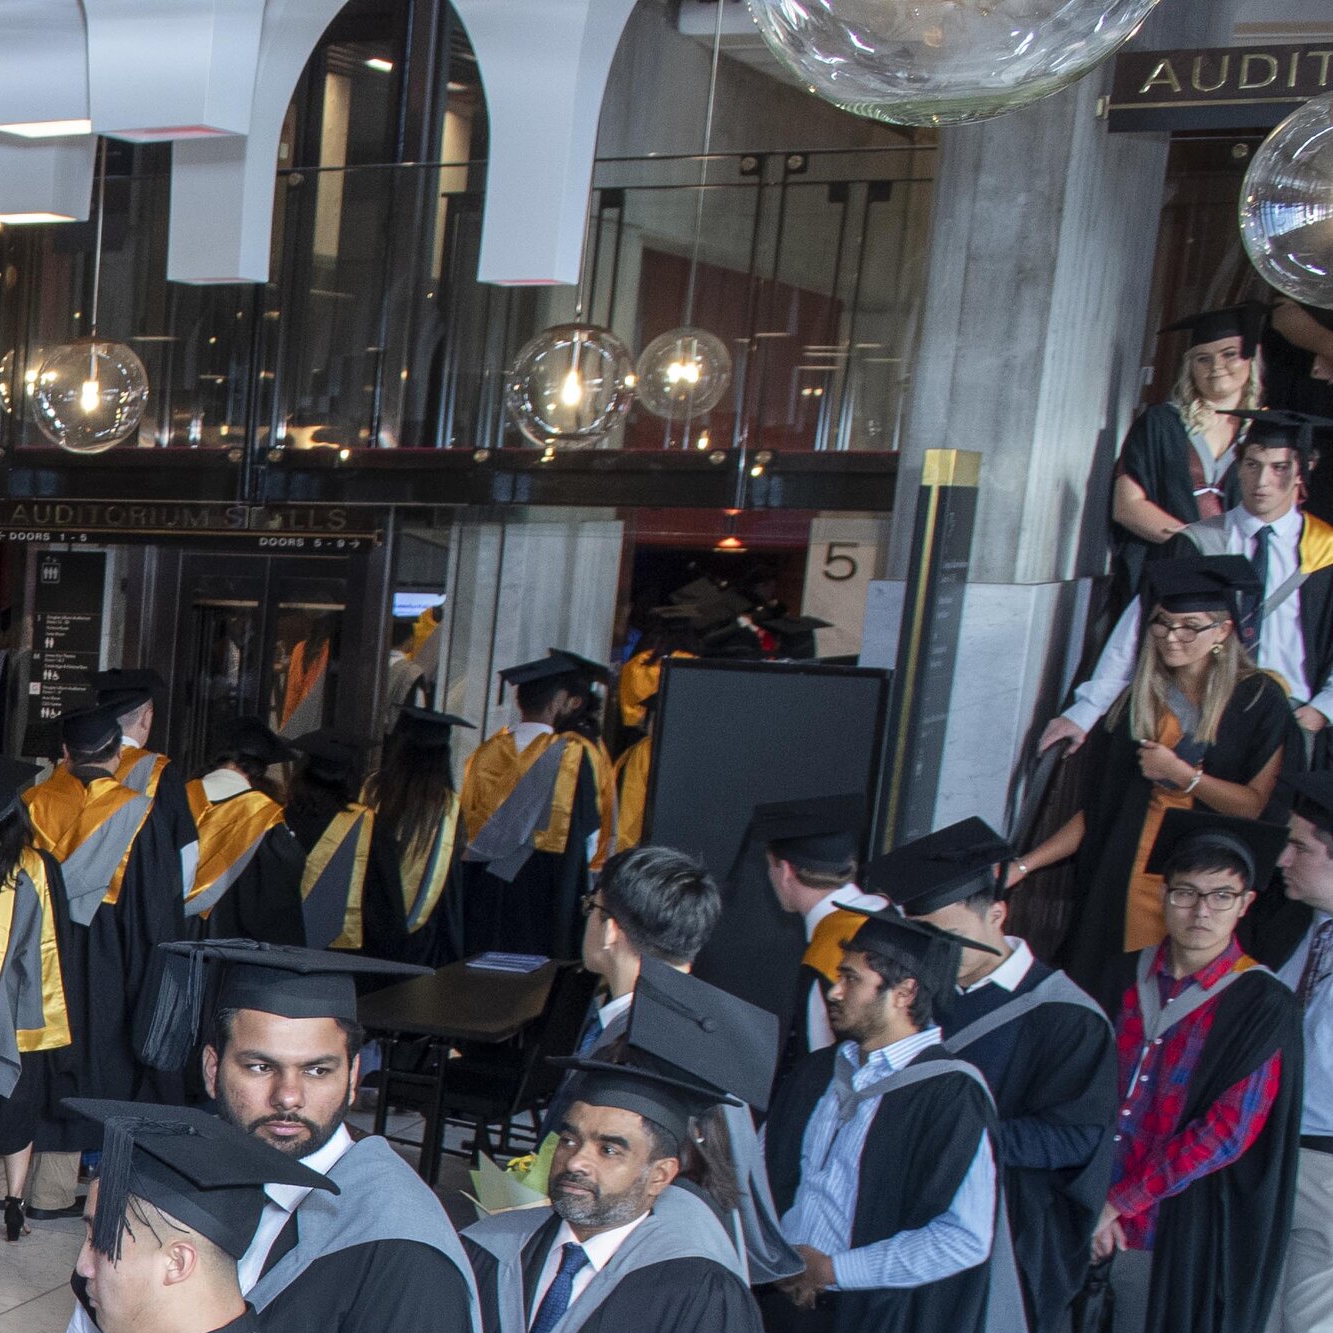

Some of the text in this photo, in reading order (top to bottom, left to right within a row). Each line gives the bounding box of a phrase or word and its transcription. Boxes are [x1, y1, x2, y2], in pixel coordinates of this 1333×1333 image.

[10, 504, 347, 530] AUDITORIUM SLLS
[9, 532, 50, 541] DOORS
[258, 537, 305, 546] DOORS
[822, 542, 859, 581] 5
